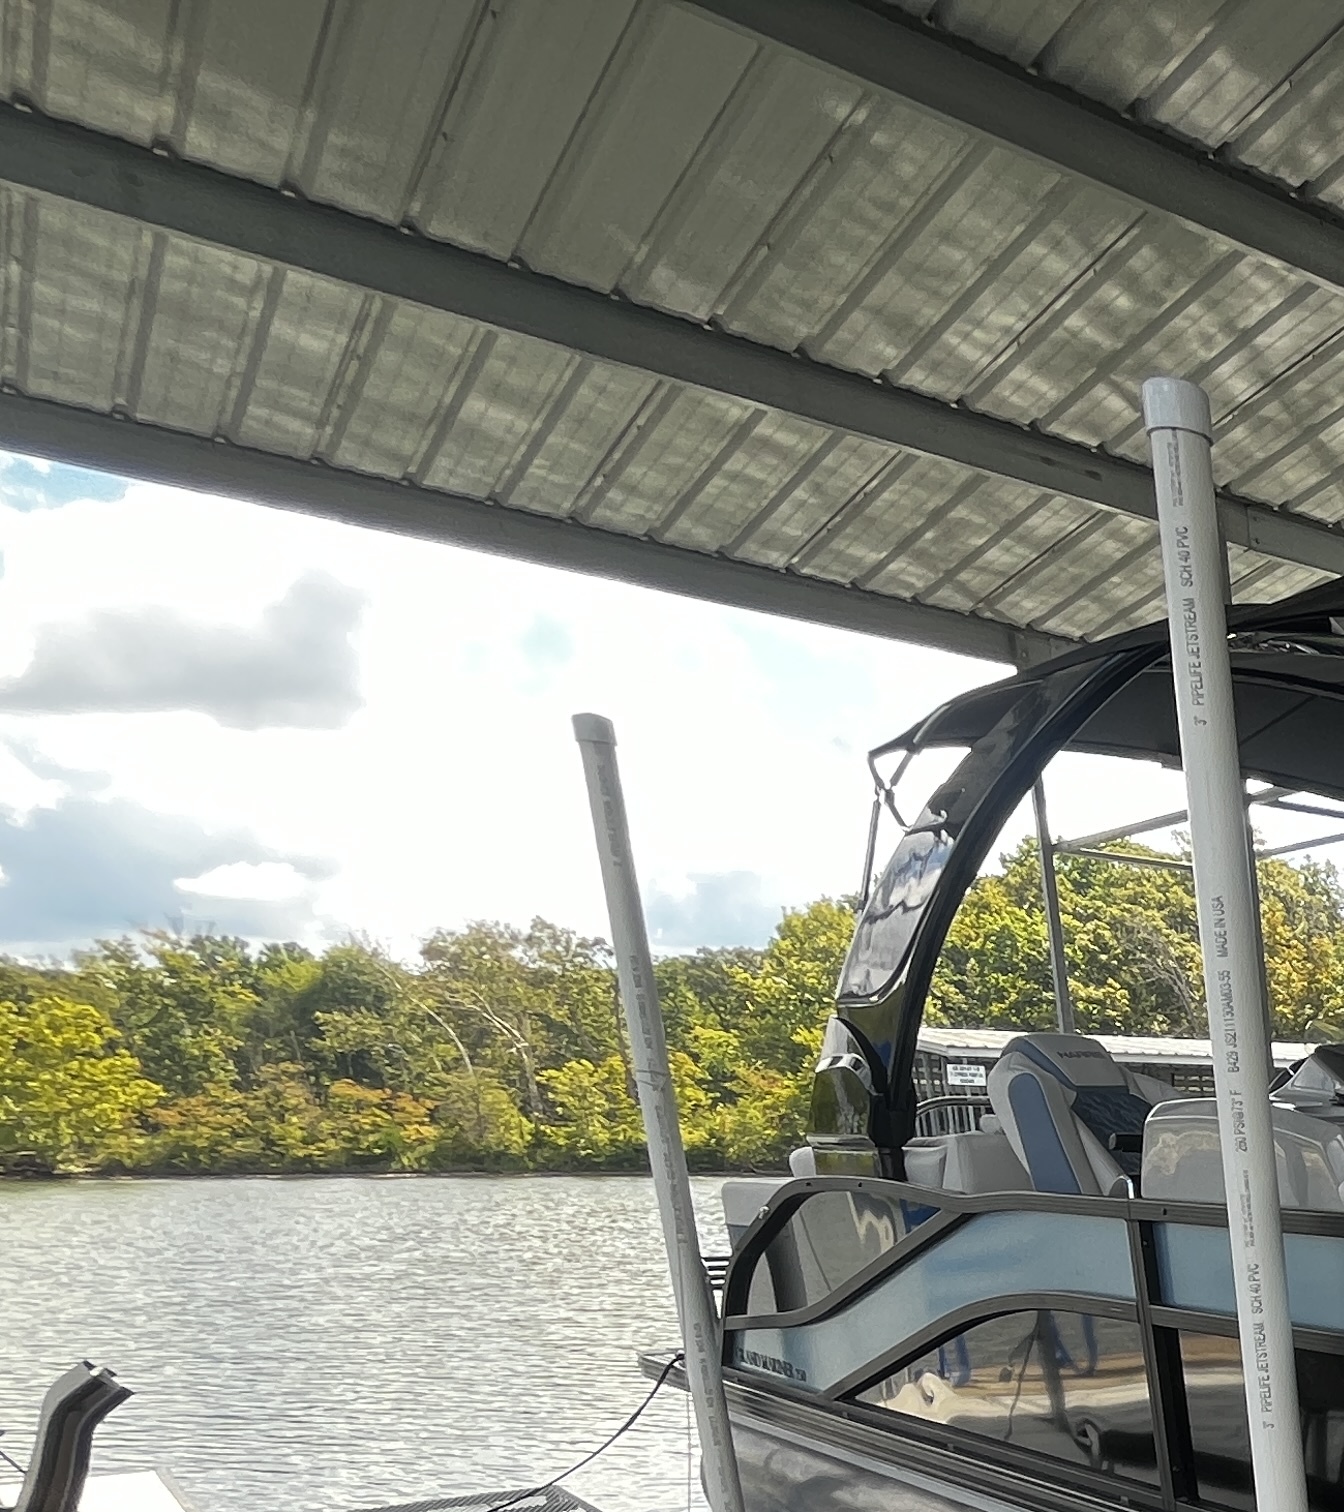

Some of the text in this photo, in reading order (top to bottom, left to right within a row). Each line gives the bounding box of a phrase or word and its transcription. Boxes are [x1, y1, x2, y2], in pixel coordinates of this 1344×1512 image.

[1175, 526, 1190, 548] PVC
[1178, 550, 1190, 563] 40
[1178, 565, 1193, 587] SCH
[1182, 597, 1201, 660] JETSTREAM
[1188, 661, 1205, 706] PIPELIFE
[1211, 895, 1225, 916] USA
[1212, 918, 1226, 929] IN
[1214, 930, 1229, 958] MADE
[1247, 1263, 1260, 1282] PVC
[1250, 1283, 1262, 1294] 40
[1251, 1295, 1264, 1314] SCH
[1253, 1322, 1270, 1373] JETSTREAM
